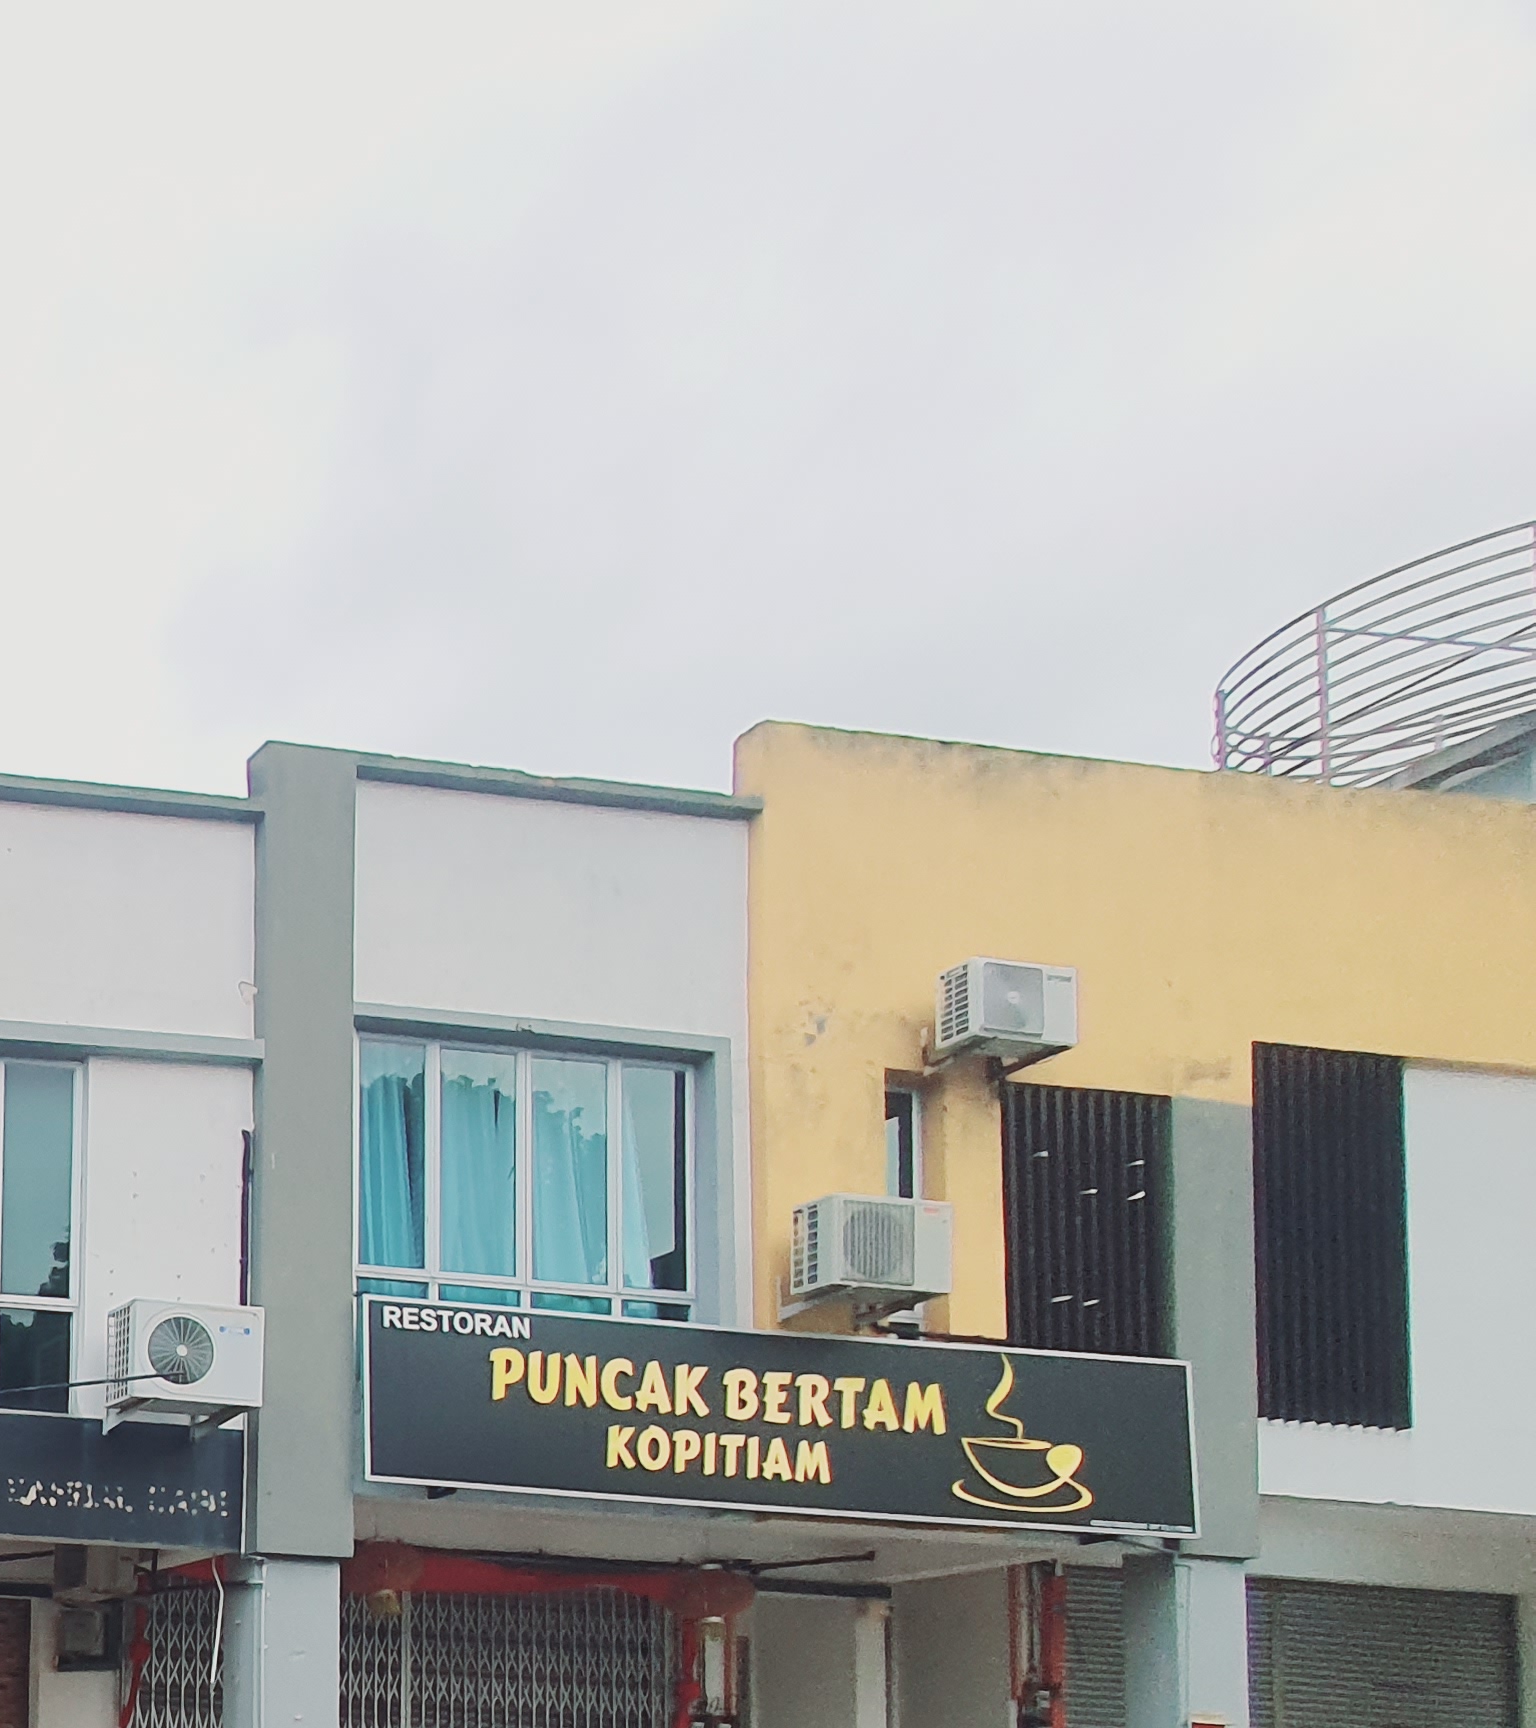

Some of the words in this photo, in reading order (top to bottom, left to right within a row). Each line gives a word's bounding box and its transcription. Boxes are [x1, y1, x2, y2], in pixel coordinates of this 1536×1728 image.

[382, 1305, 532, 1340] RESTORAN
[488, 1346, 710, 1419] PUNCAK
[722, 1367, 948, 1437] BERTAM
[604, 1423, 832, 1486] KOPITIAM
